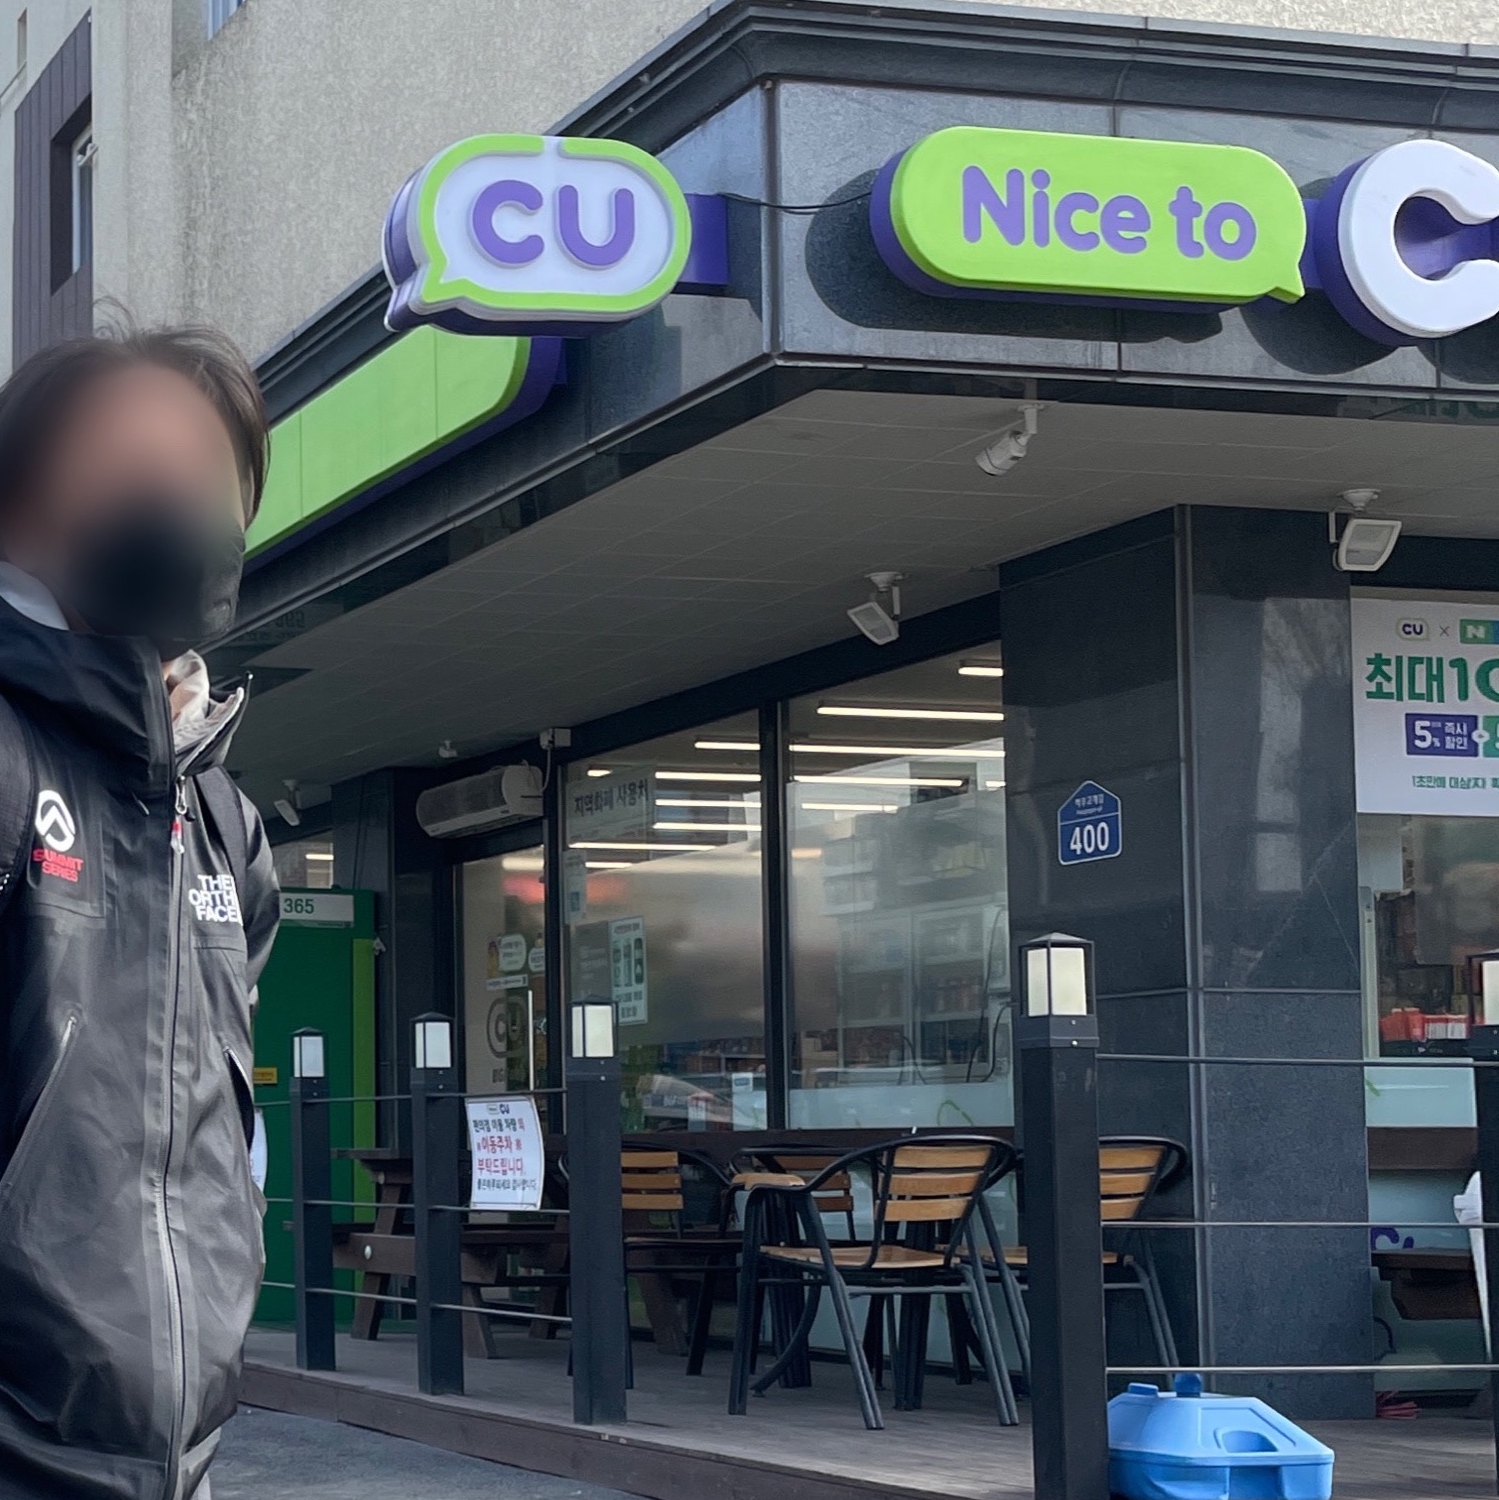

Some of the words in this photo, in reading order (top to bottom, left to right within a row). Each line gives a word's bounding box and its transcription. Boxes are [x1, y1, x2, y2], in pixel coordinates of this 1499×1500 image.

[470, 178, 636, 268] CU
[961, 165, 1152, 255] Nice
[1168, 185, 1257, 262] to
[1401, 622, 1424, 636] CU
[1444, 736, 1468, 750] 할인
[1069, 821, 1110, 856] 400
[33, 848, 84, 871] SUMMIT
[197, 874, 234, 891] THE
[188, 888, 238, 907] ORTH
[283, 897, 315, 915] 365
[195, 905, 239, 923] FACE
[481, 1135, 513, 1154] 이동주차
